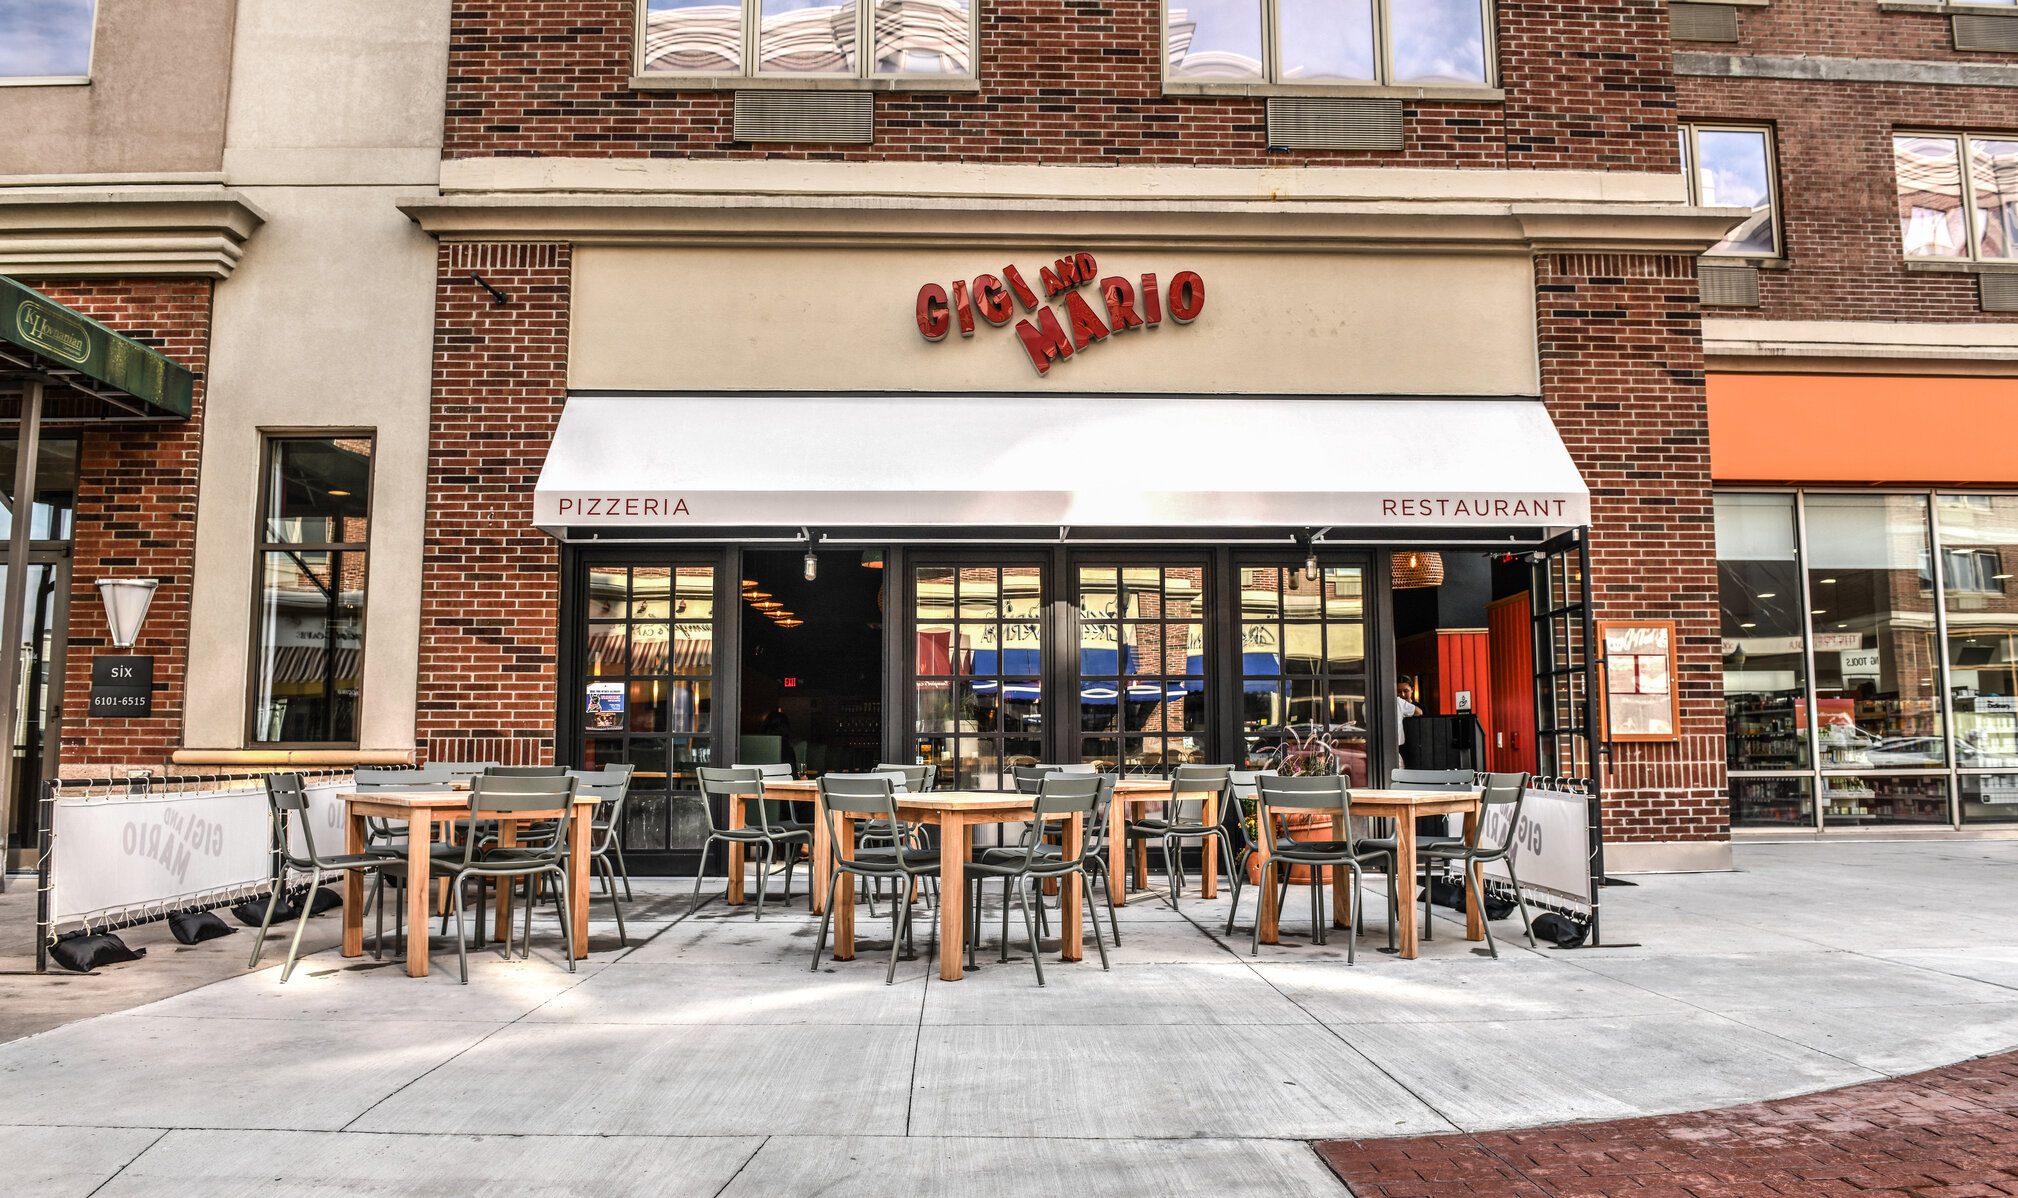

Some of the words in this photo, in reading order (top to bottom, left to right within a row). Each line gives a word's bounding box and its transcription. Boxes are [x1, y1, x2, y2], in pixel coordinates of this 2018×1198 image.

[915, 263, 1039, 342] GIGI
[1039, 251, 1098, 298] AND
[1014, 270, 1206, 377] MARIO
[559, 498, 690, 516] PIZZERIA
[1382, 499, 1566, 517] RESTAURANT
[111, 664, 133, 678] six
[94, 696, 146, 706] 6101-6515
